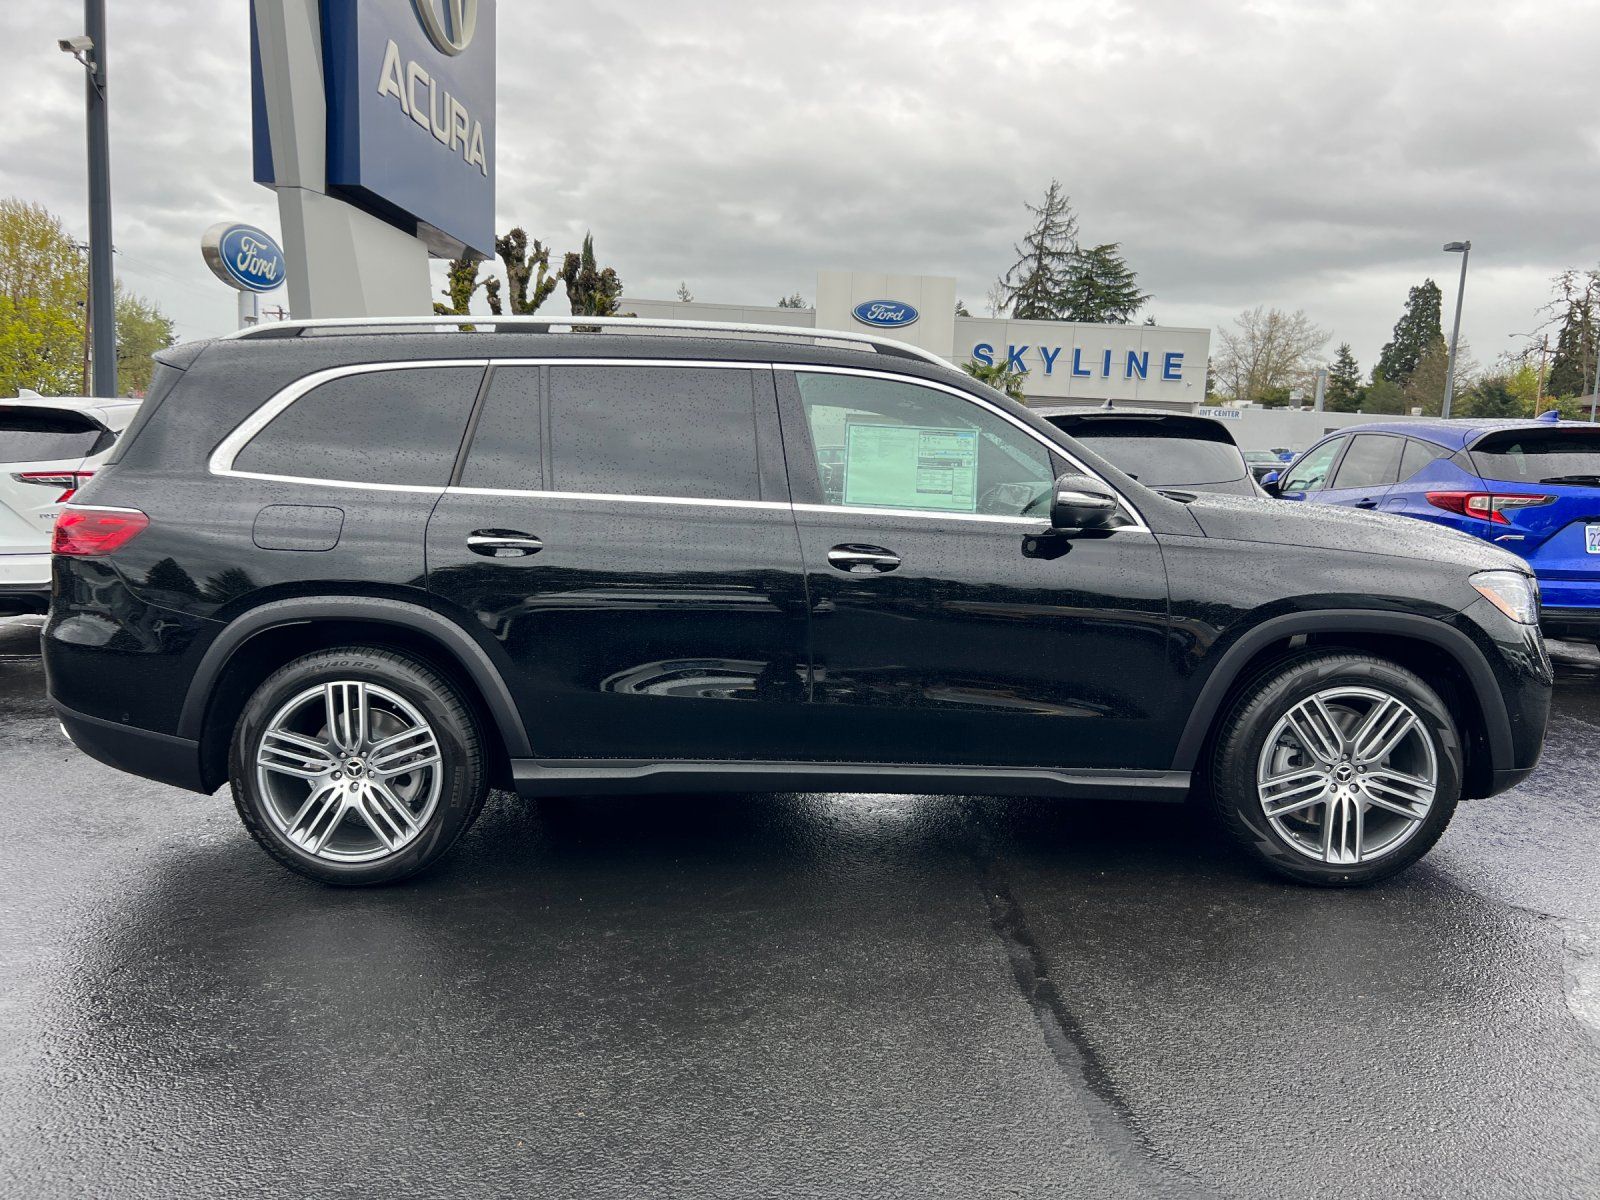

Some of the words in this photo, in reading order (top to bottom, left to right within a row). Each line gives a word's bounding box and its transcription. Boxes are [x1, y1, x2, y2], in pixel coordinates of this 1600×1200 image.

[377, 38, 488, 178] ACURA
[237, 236, 277, 280] Ford
[867, 303, 905, 321] Ford
[972, 343, 1184, 381] SKYLINE
